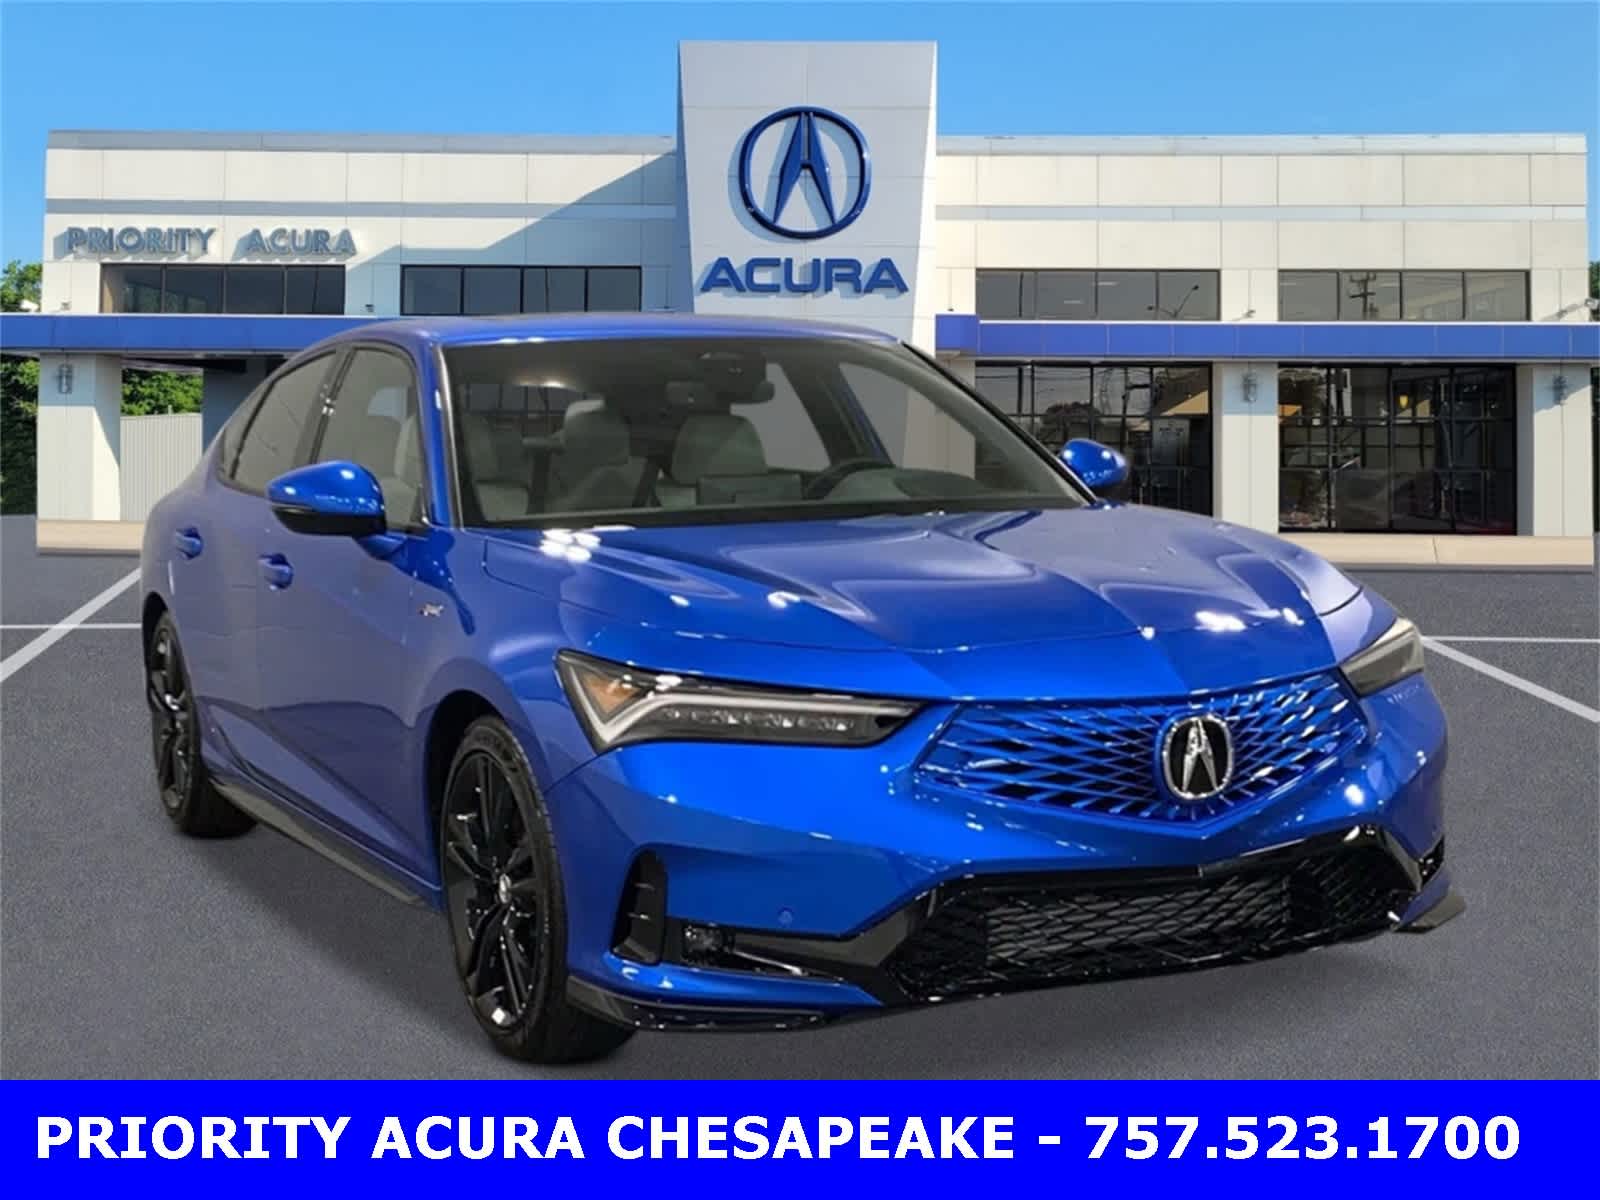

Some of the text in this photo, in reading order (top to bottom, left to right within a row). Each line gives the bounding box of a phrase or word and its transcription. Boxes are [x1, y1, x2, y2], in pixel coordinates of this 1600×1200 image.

[64, 226, 357, 256] PRIORITY ACURA
[700, 257, 909, 293] ACURA
